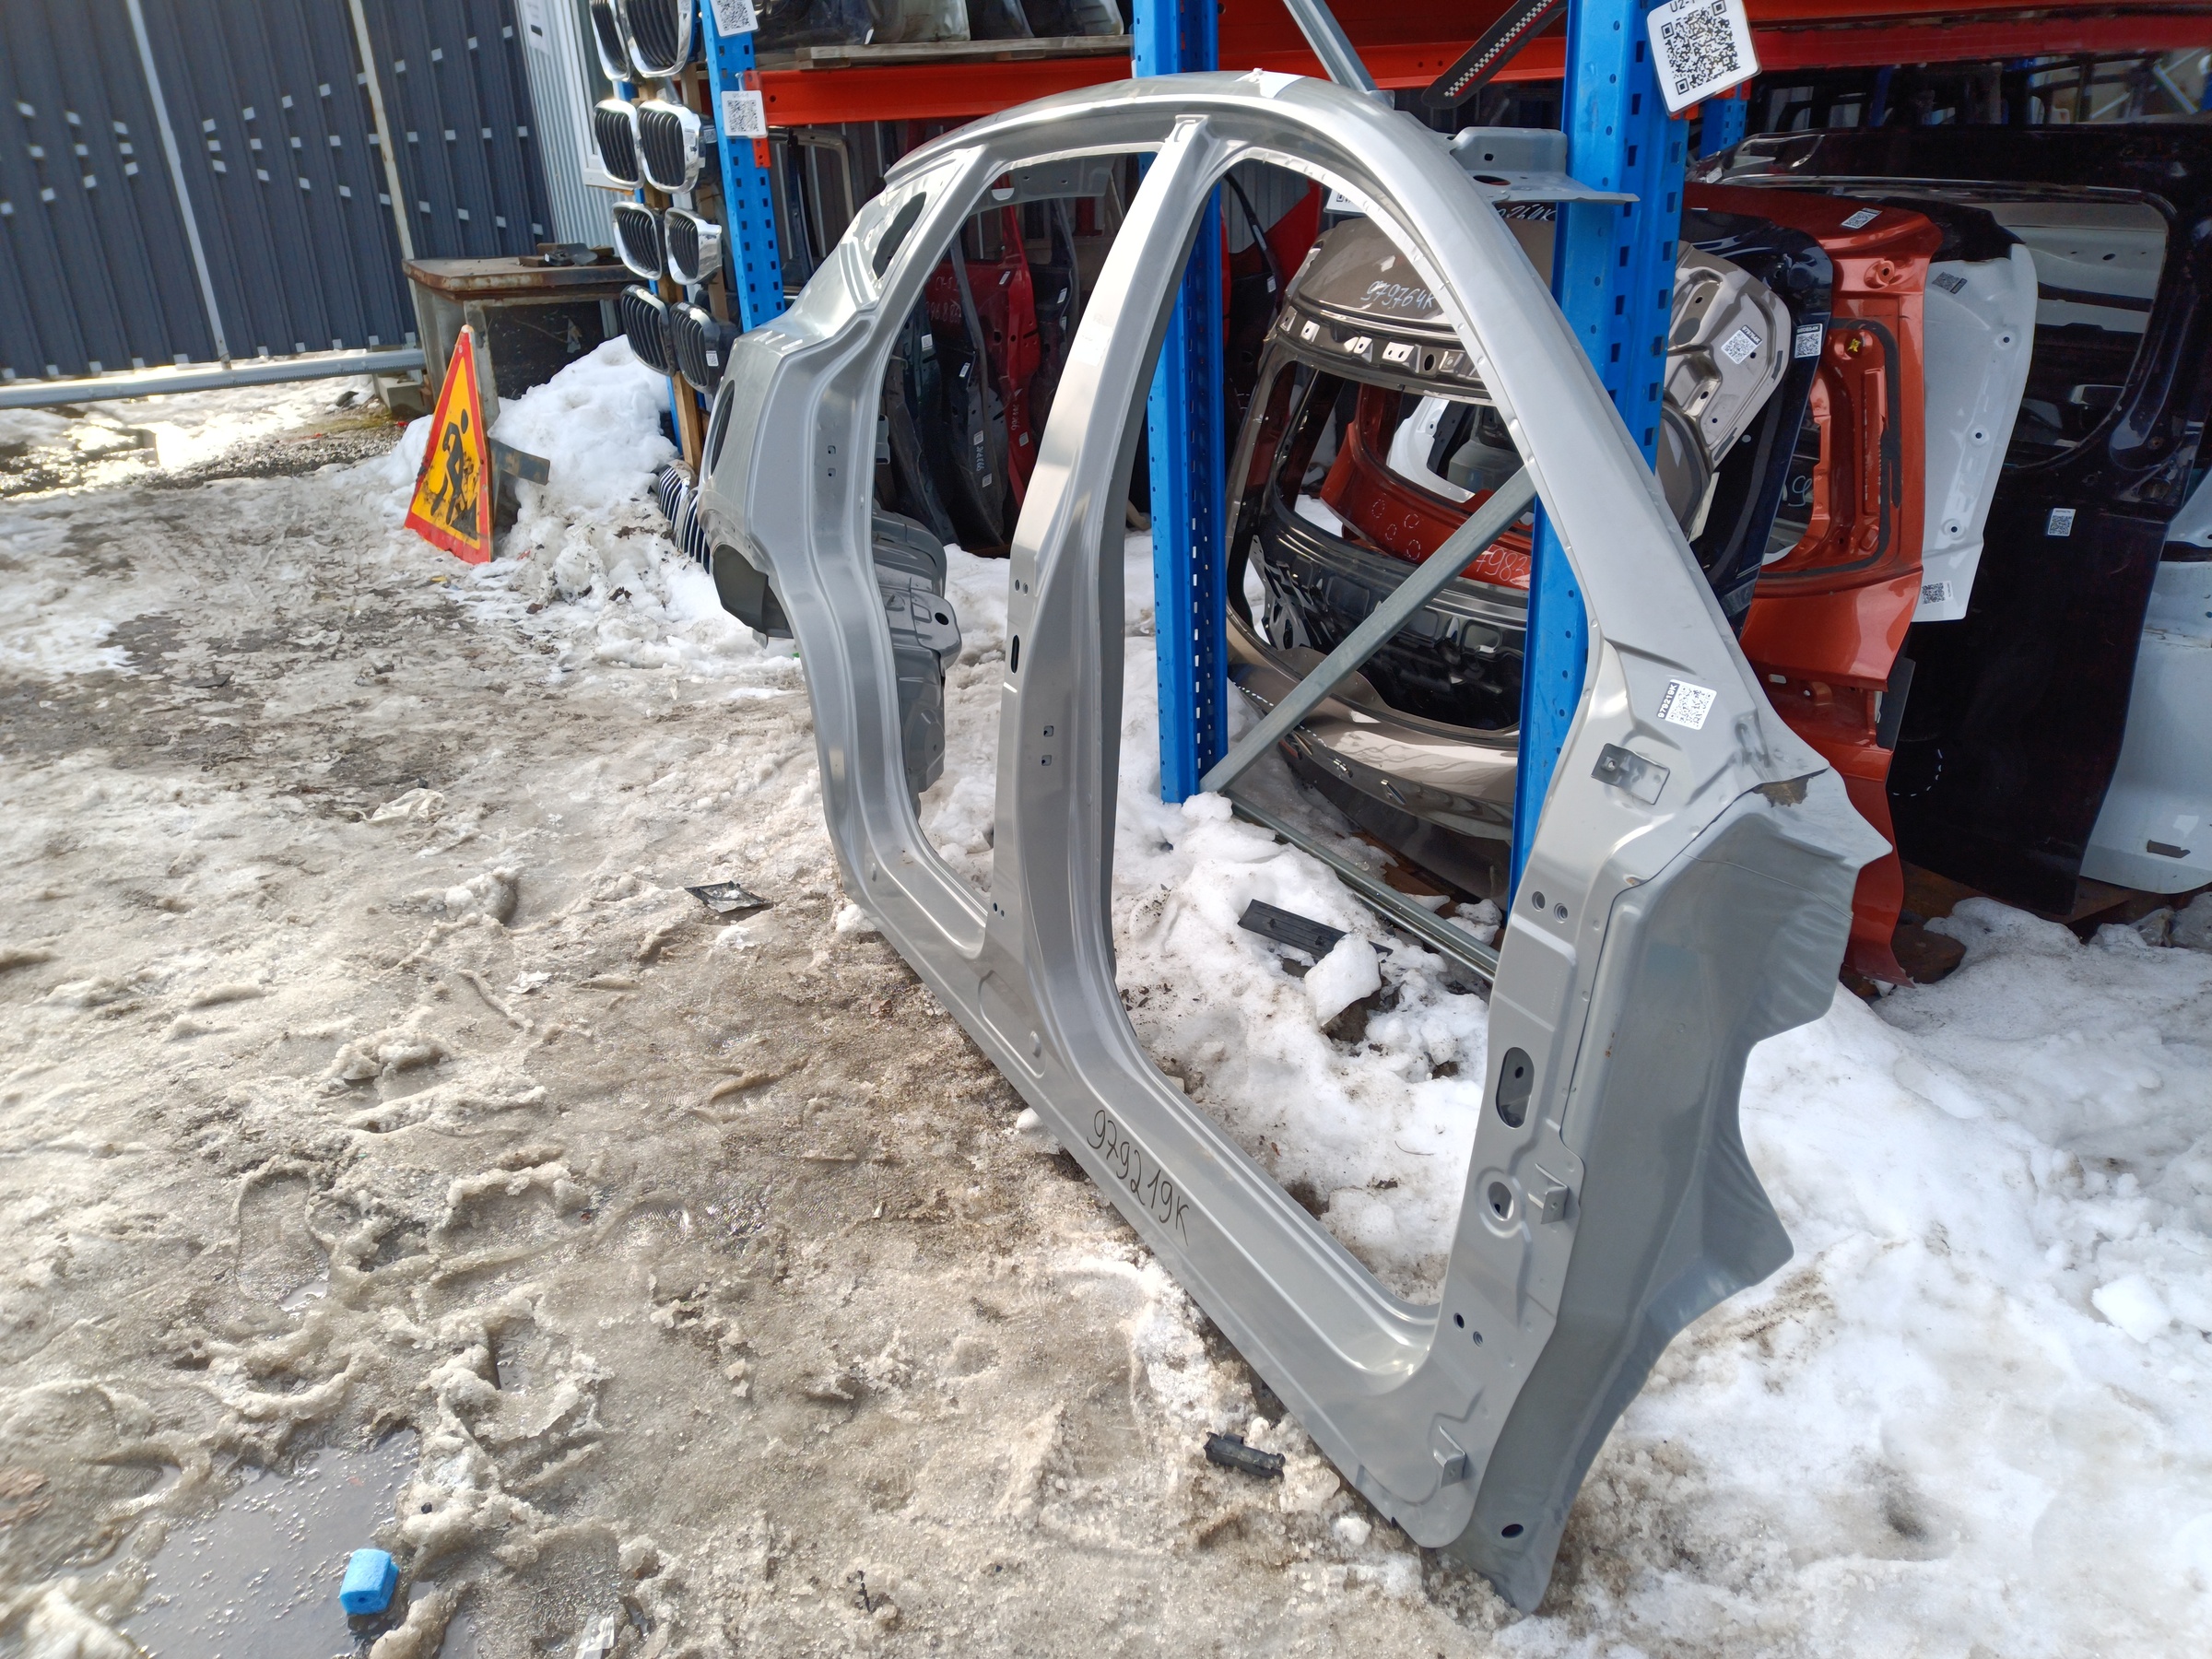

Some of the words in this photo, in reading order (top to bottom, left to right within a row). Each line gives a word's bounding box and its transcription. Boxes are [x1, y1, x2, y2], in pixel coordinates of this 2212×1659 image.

[1669, 0, 1695, 12] U2-
[1657, 684, 1677, 719] 979219K
[1087, 1110, 1189, 1246] 979219K
